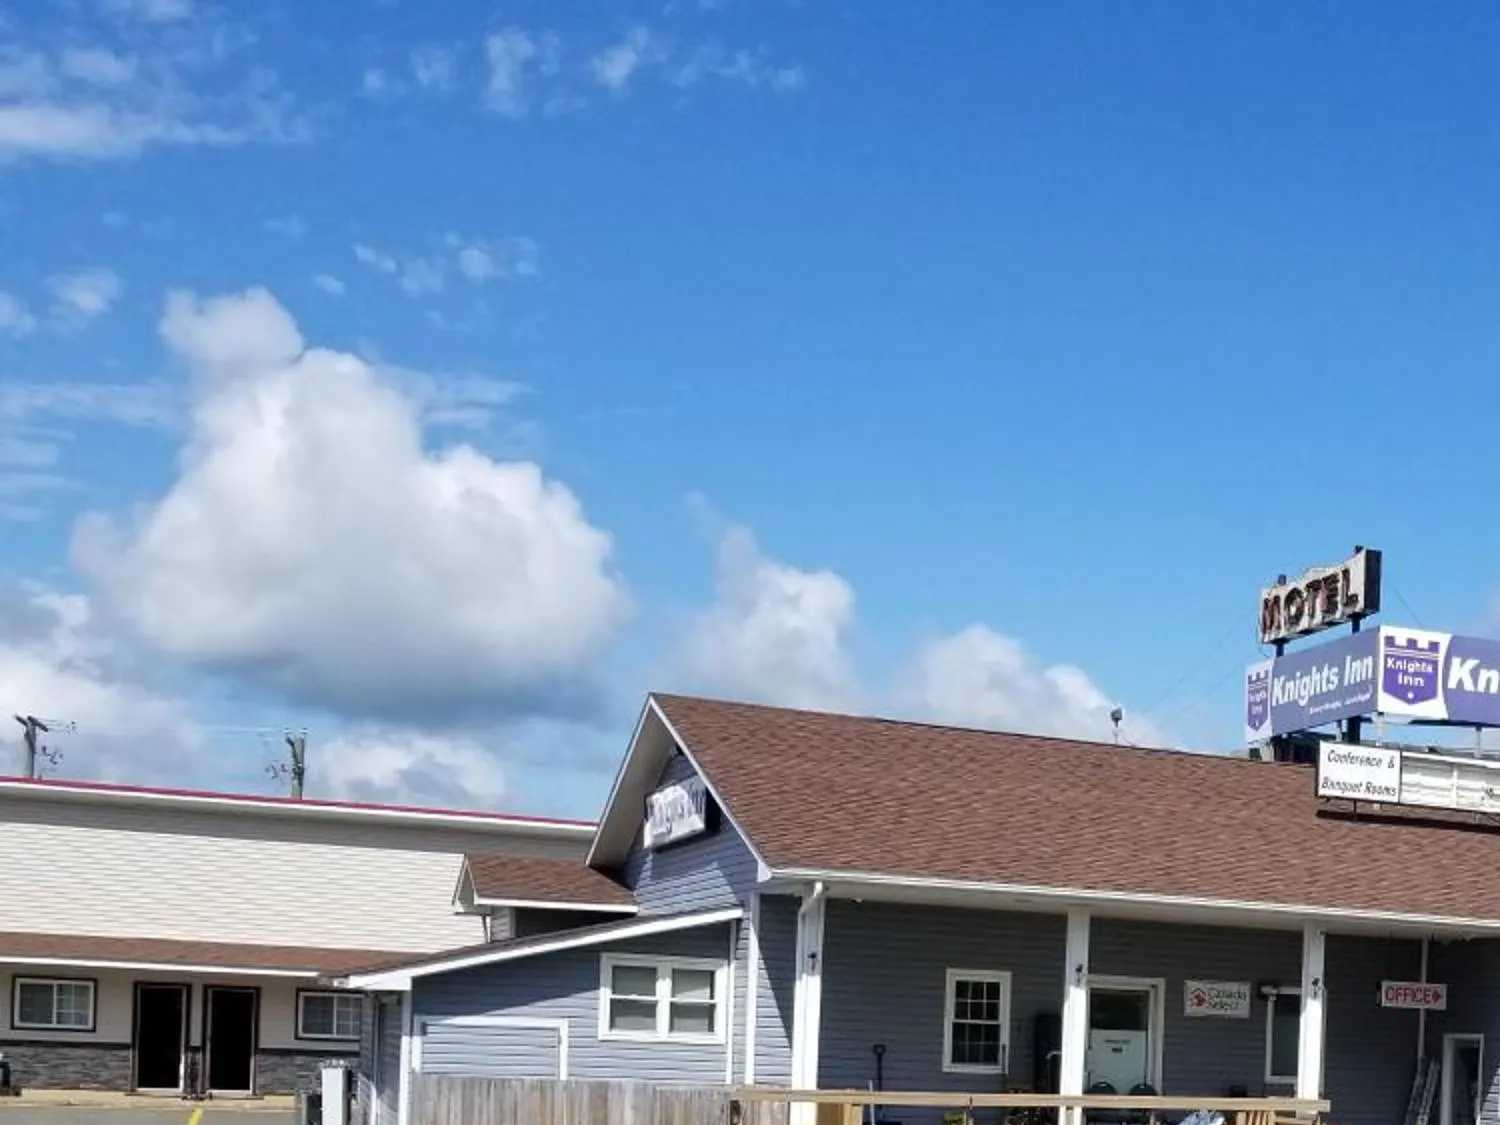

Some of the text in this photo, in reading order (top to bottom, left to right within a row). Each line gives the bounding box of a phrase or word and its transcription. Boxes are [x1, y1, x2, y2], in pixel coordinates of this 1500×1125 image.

[1262, 568, 1359, 634] MOTEL
[1387, 657, 1433, 674] Knights
[1272, 663, 1339, 706] Knights
[1343, 655, 1374, 687] Inn
[1397, 672, 1425, 688] Inn
[1327, 749, 1383, 768] Conference
[1322, 776, 1398, 797] Banquet Rooms
[1385, 986, 1434, 1004] OFFICE
